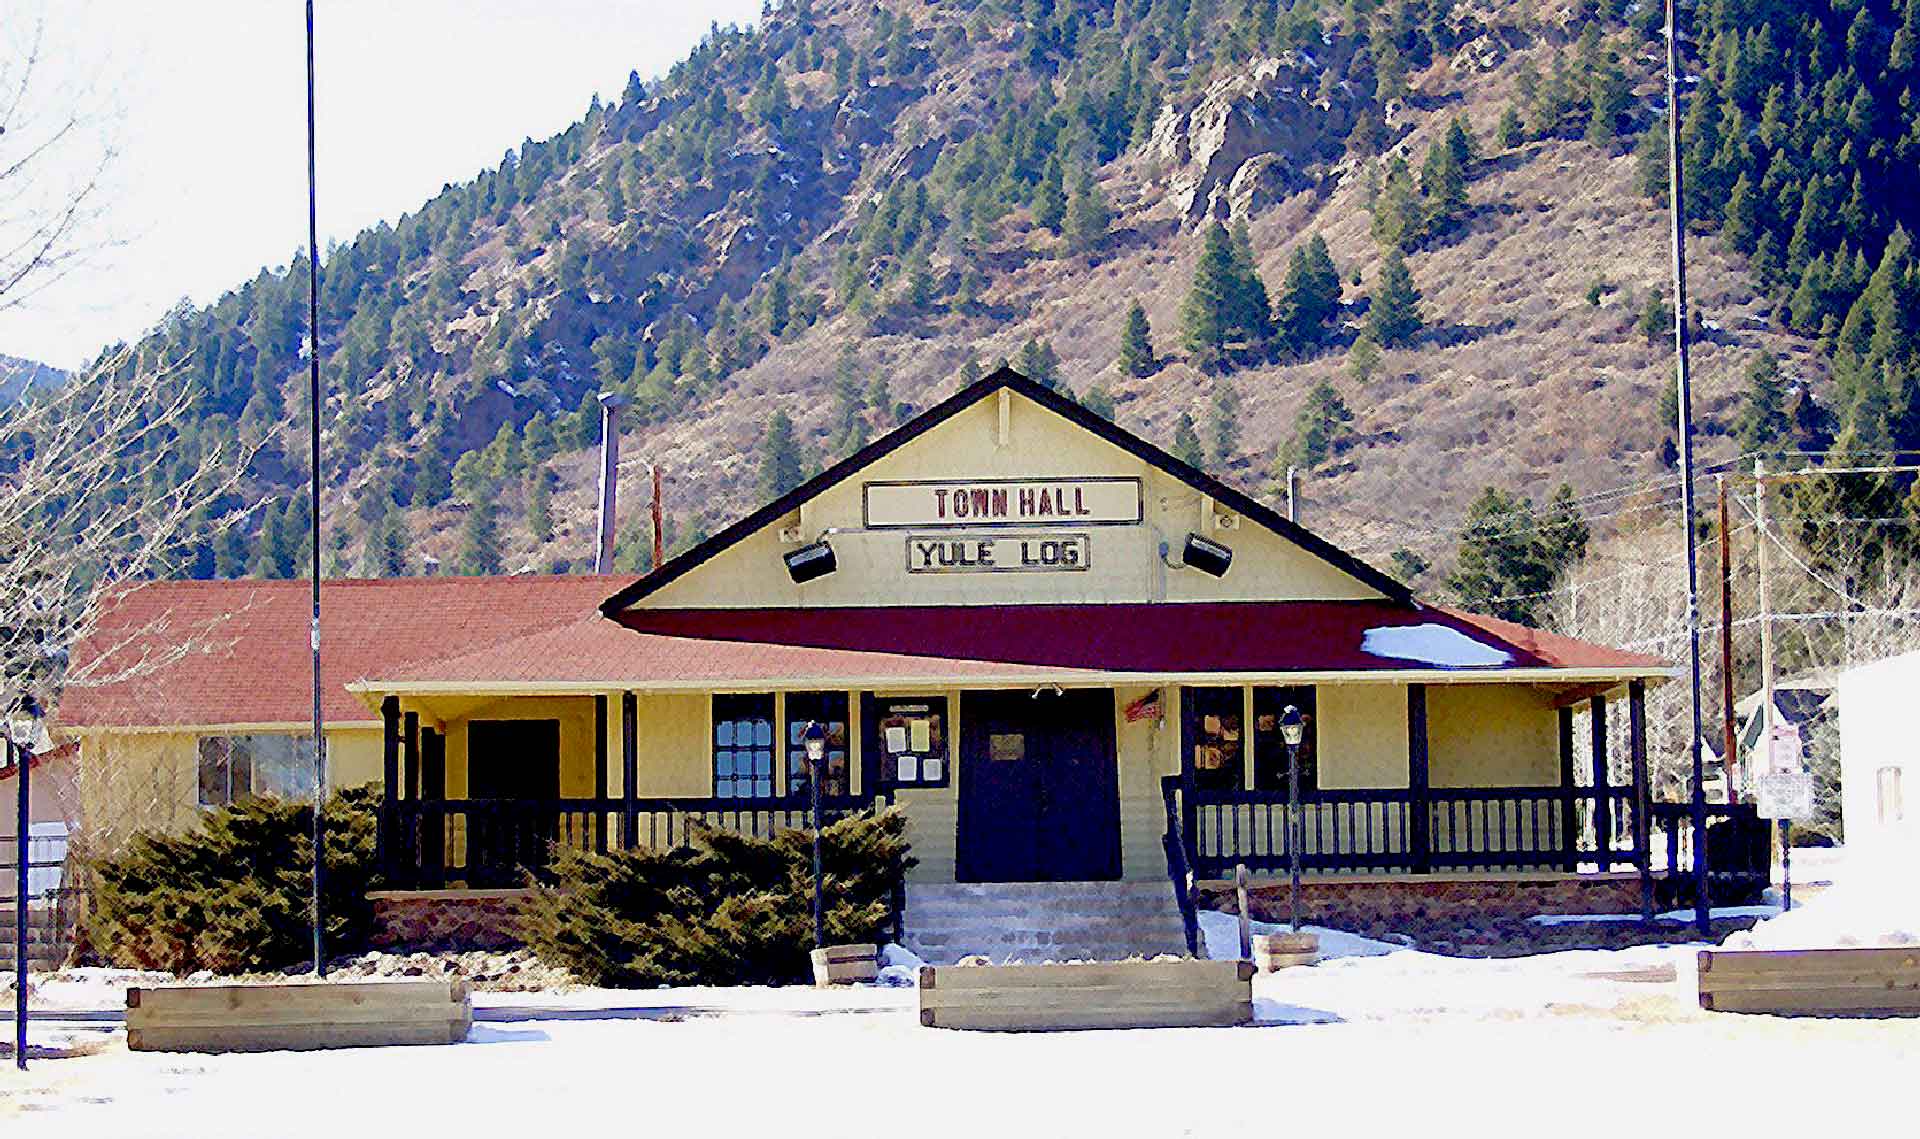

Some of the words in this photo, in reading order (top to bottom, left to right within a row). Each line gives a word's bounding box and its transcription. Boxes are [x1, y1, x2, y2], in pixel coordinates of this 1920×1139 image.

[935, 489, 1008, 518] TOWN
[1019, 487, 1091, 516] HALL
[917, 541, 995, 566] YULE
[1021, 541, 1079, 565] LOG
